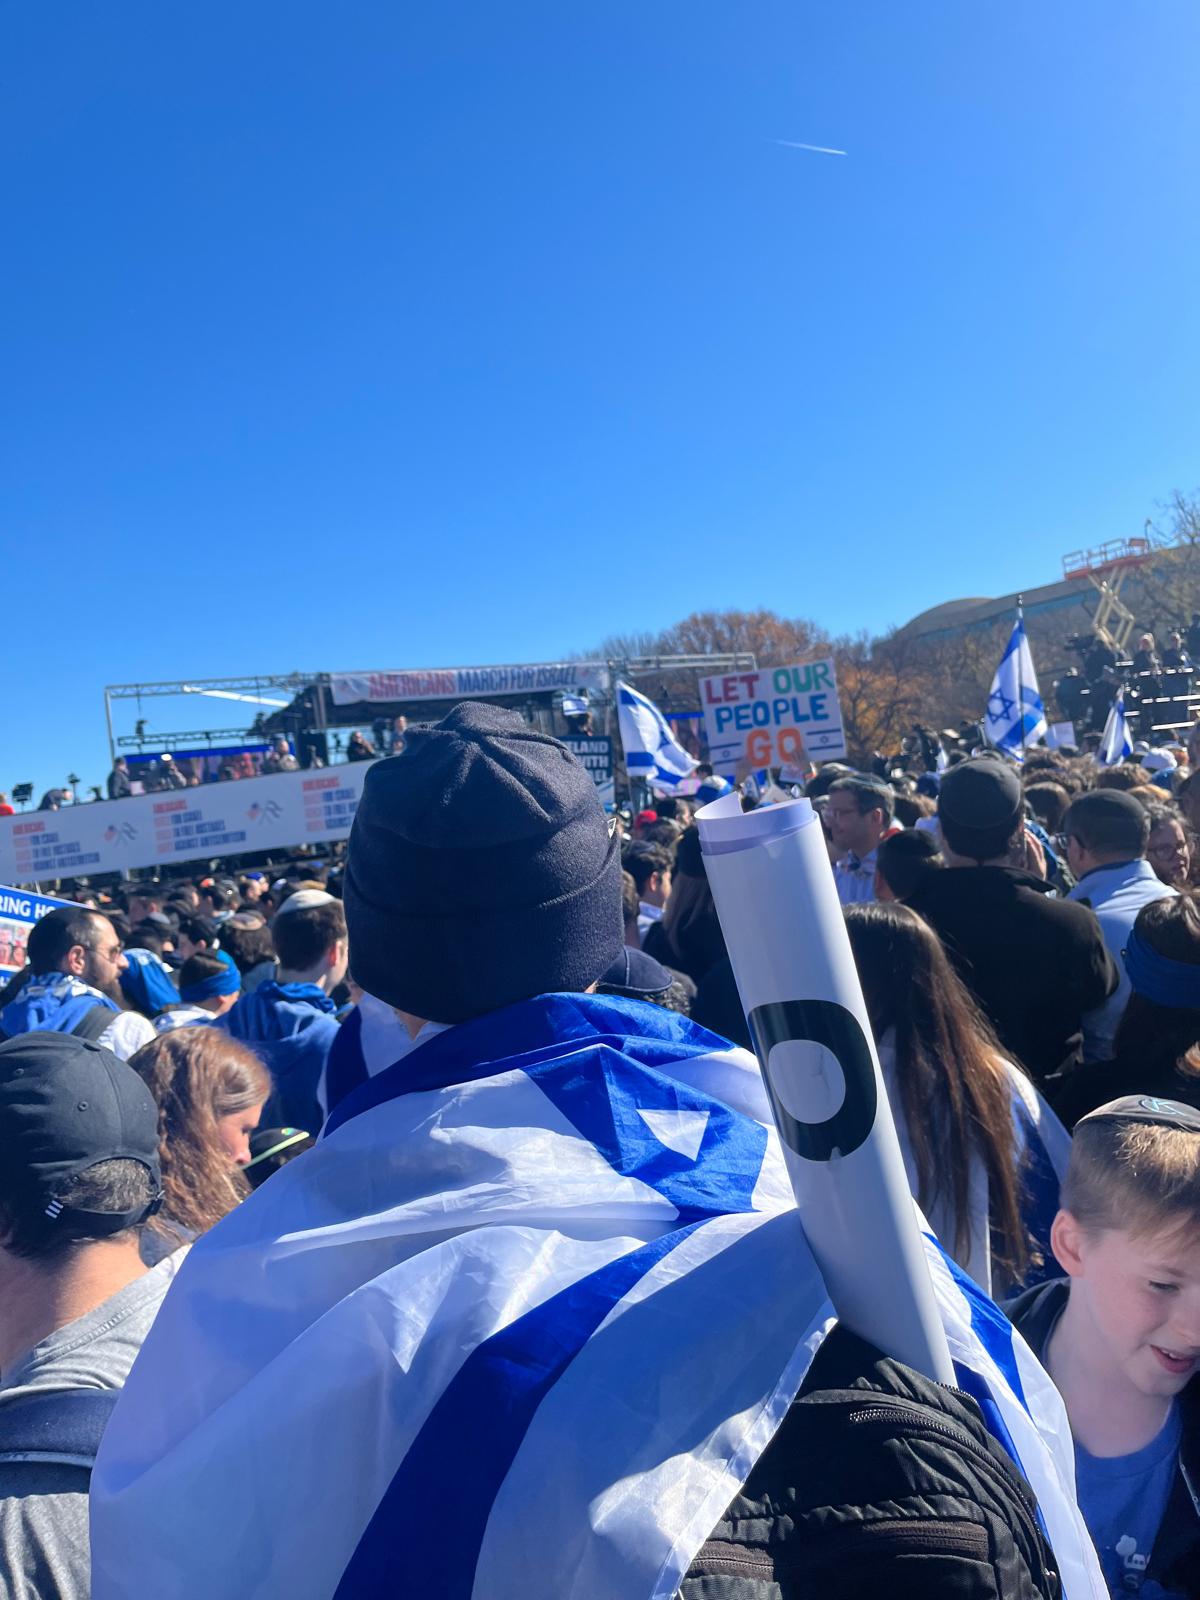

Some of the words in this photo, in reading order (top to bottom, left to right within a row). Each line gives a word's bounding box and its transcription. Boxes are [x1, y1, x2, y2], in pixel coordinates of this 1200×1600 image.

[369, 672, 456, 698] AMERICANS
[458, 669, 507, 692] MARCH
[510, 667, 535, 690] FOR
[536, 665, 577, 688] ISRAEL
[704, 674, 760, 704] LET
[772, 662, 835, 694] OUR
[715, 693, 829, 733] PEOPLE
[746, 727, 804, 768] GO
